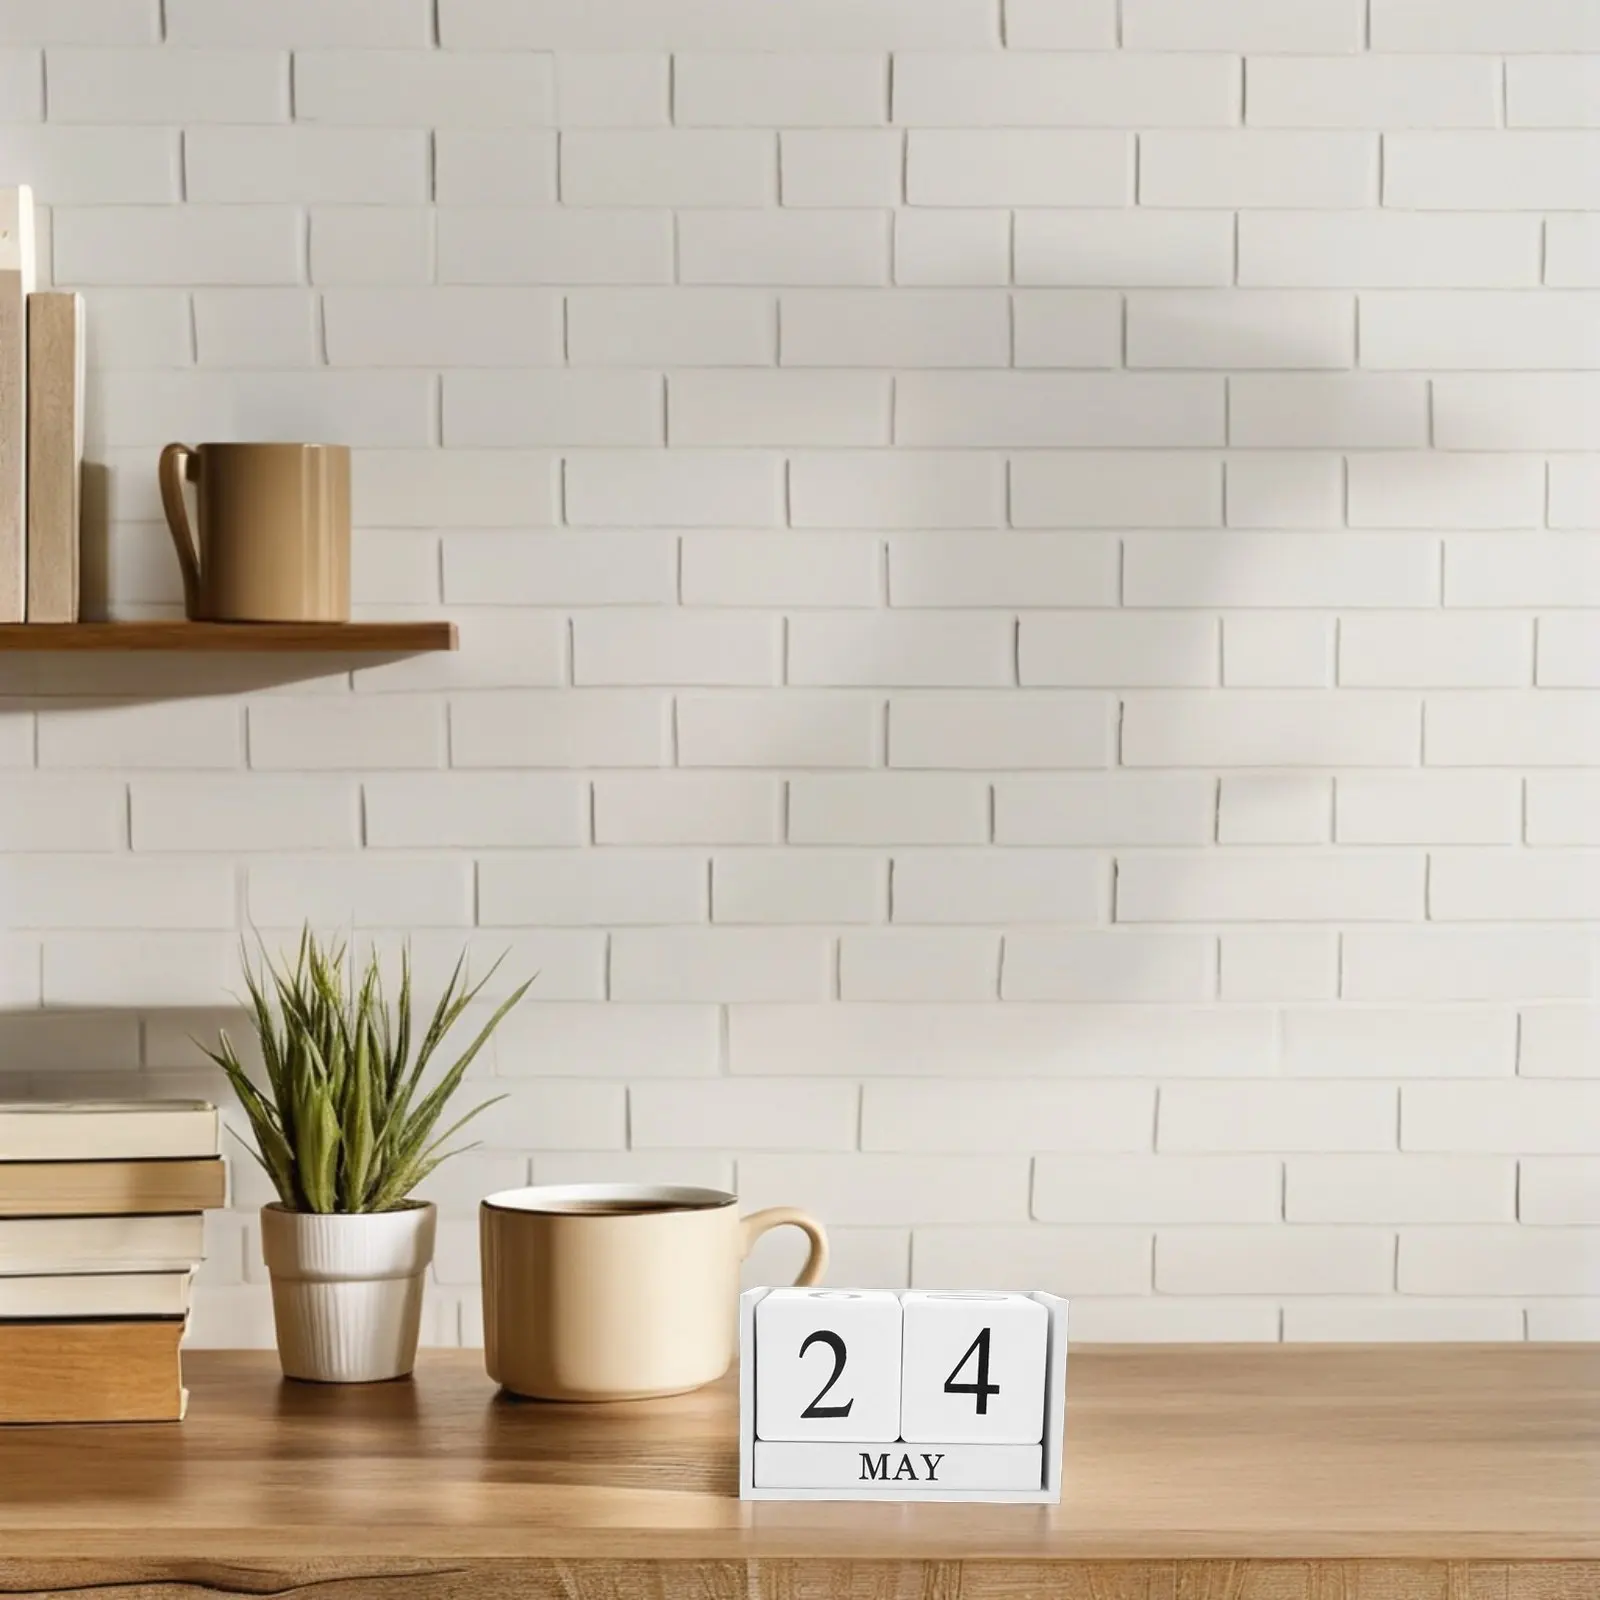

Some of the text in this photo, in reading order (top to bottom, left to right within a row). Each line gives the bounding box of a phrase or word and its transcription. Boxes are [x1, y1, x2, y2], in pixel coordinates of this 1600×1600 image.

[798, 1327, 1000, 1419] 2 4
[858, 1452, 945, 1481] MAY
